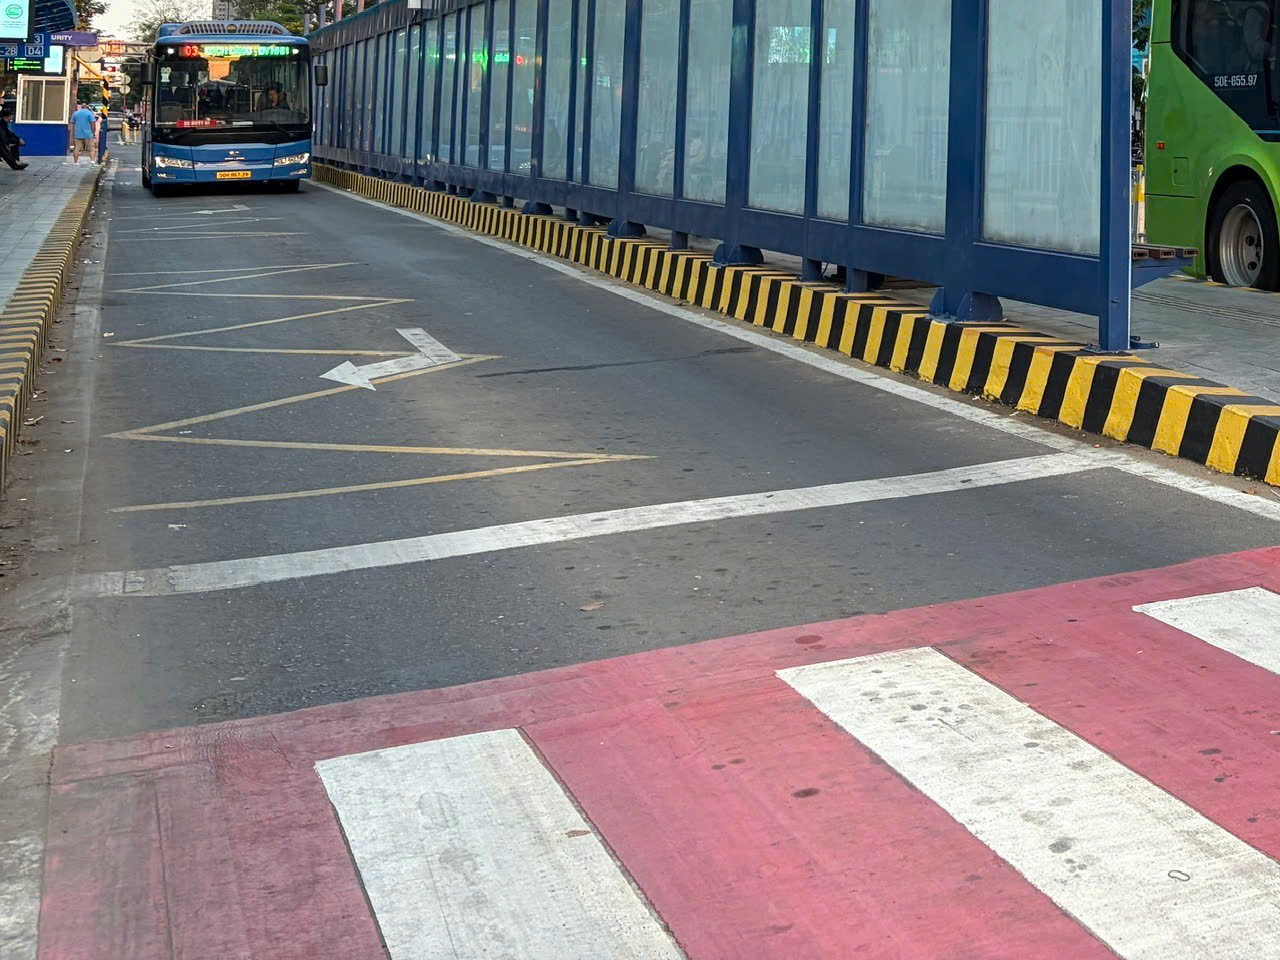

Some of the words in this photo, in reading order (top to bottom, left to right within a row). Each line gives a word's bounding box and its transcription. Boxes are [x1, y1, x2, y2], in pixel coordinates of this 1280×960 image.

[28, 47, 41, 55] D4
[184, 45, 199, 56] 03
[1214, 75, 1257, 87] 50E-655.97
